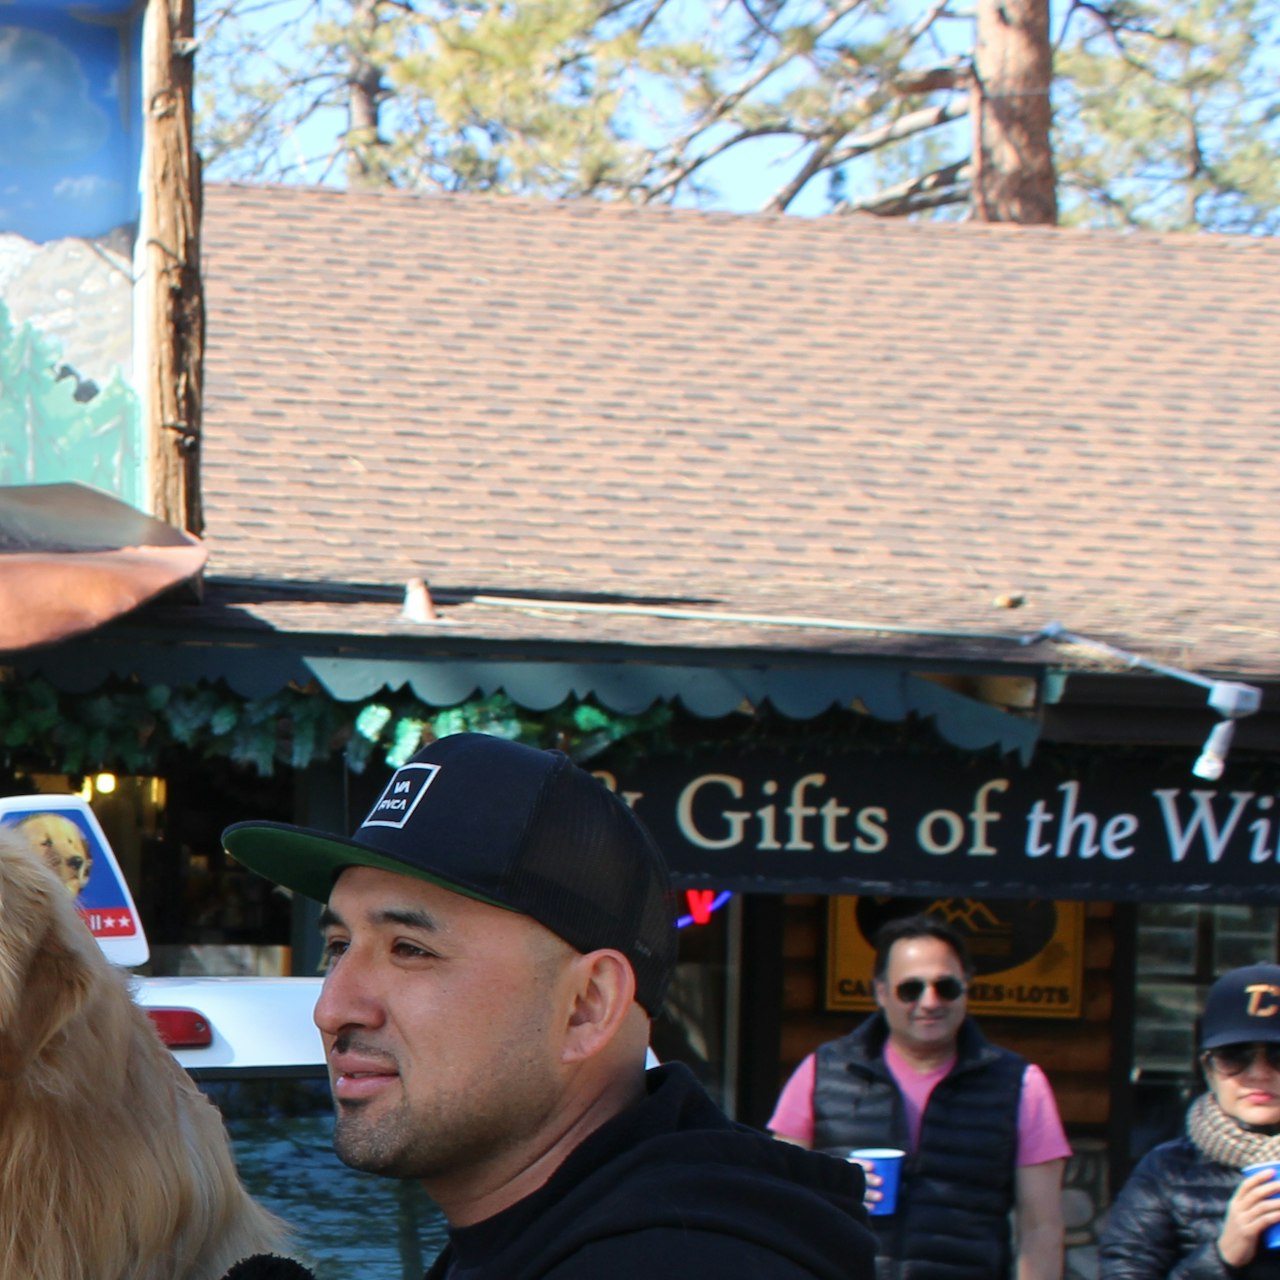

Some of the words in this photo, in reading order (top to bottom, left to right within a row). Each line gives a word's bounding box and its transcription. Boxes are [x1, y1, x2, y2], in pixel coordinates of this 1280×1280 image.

[675, 772, 889, 853] Gifts
[917, 778, 1009, 855] of
[1024, 780, 1139, 860] the
[1152, 788, 1280, 864] Wi
